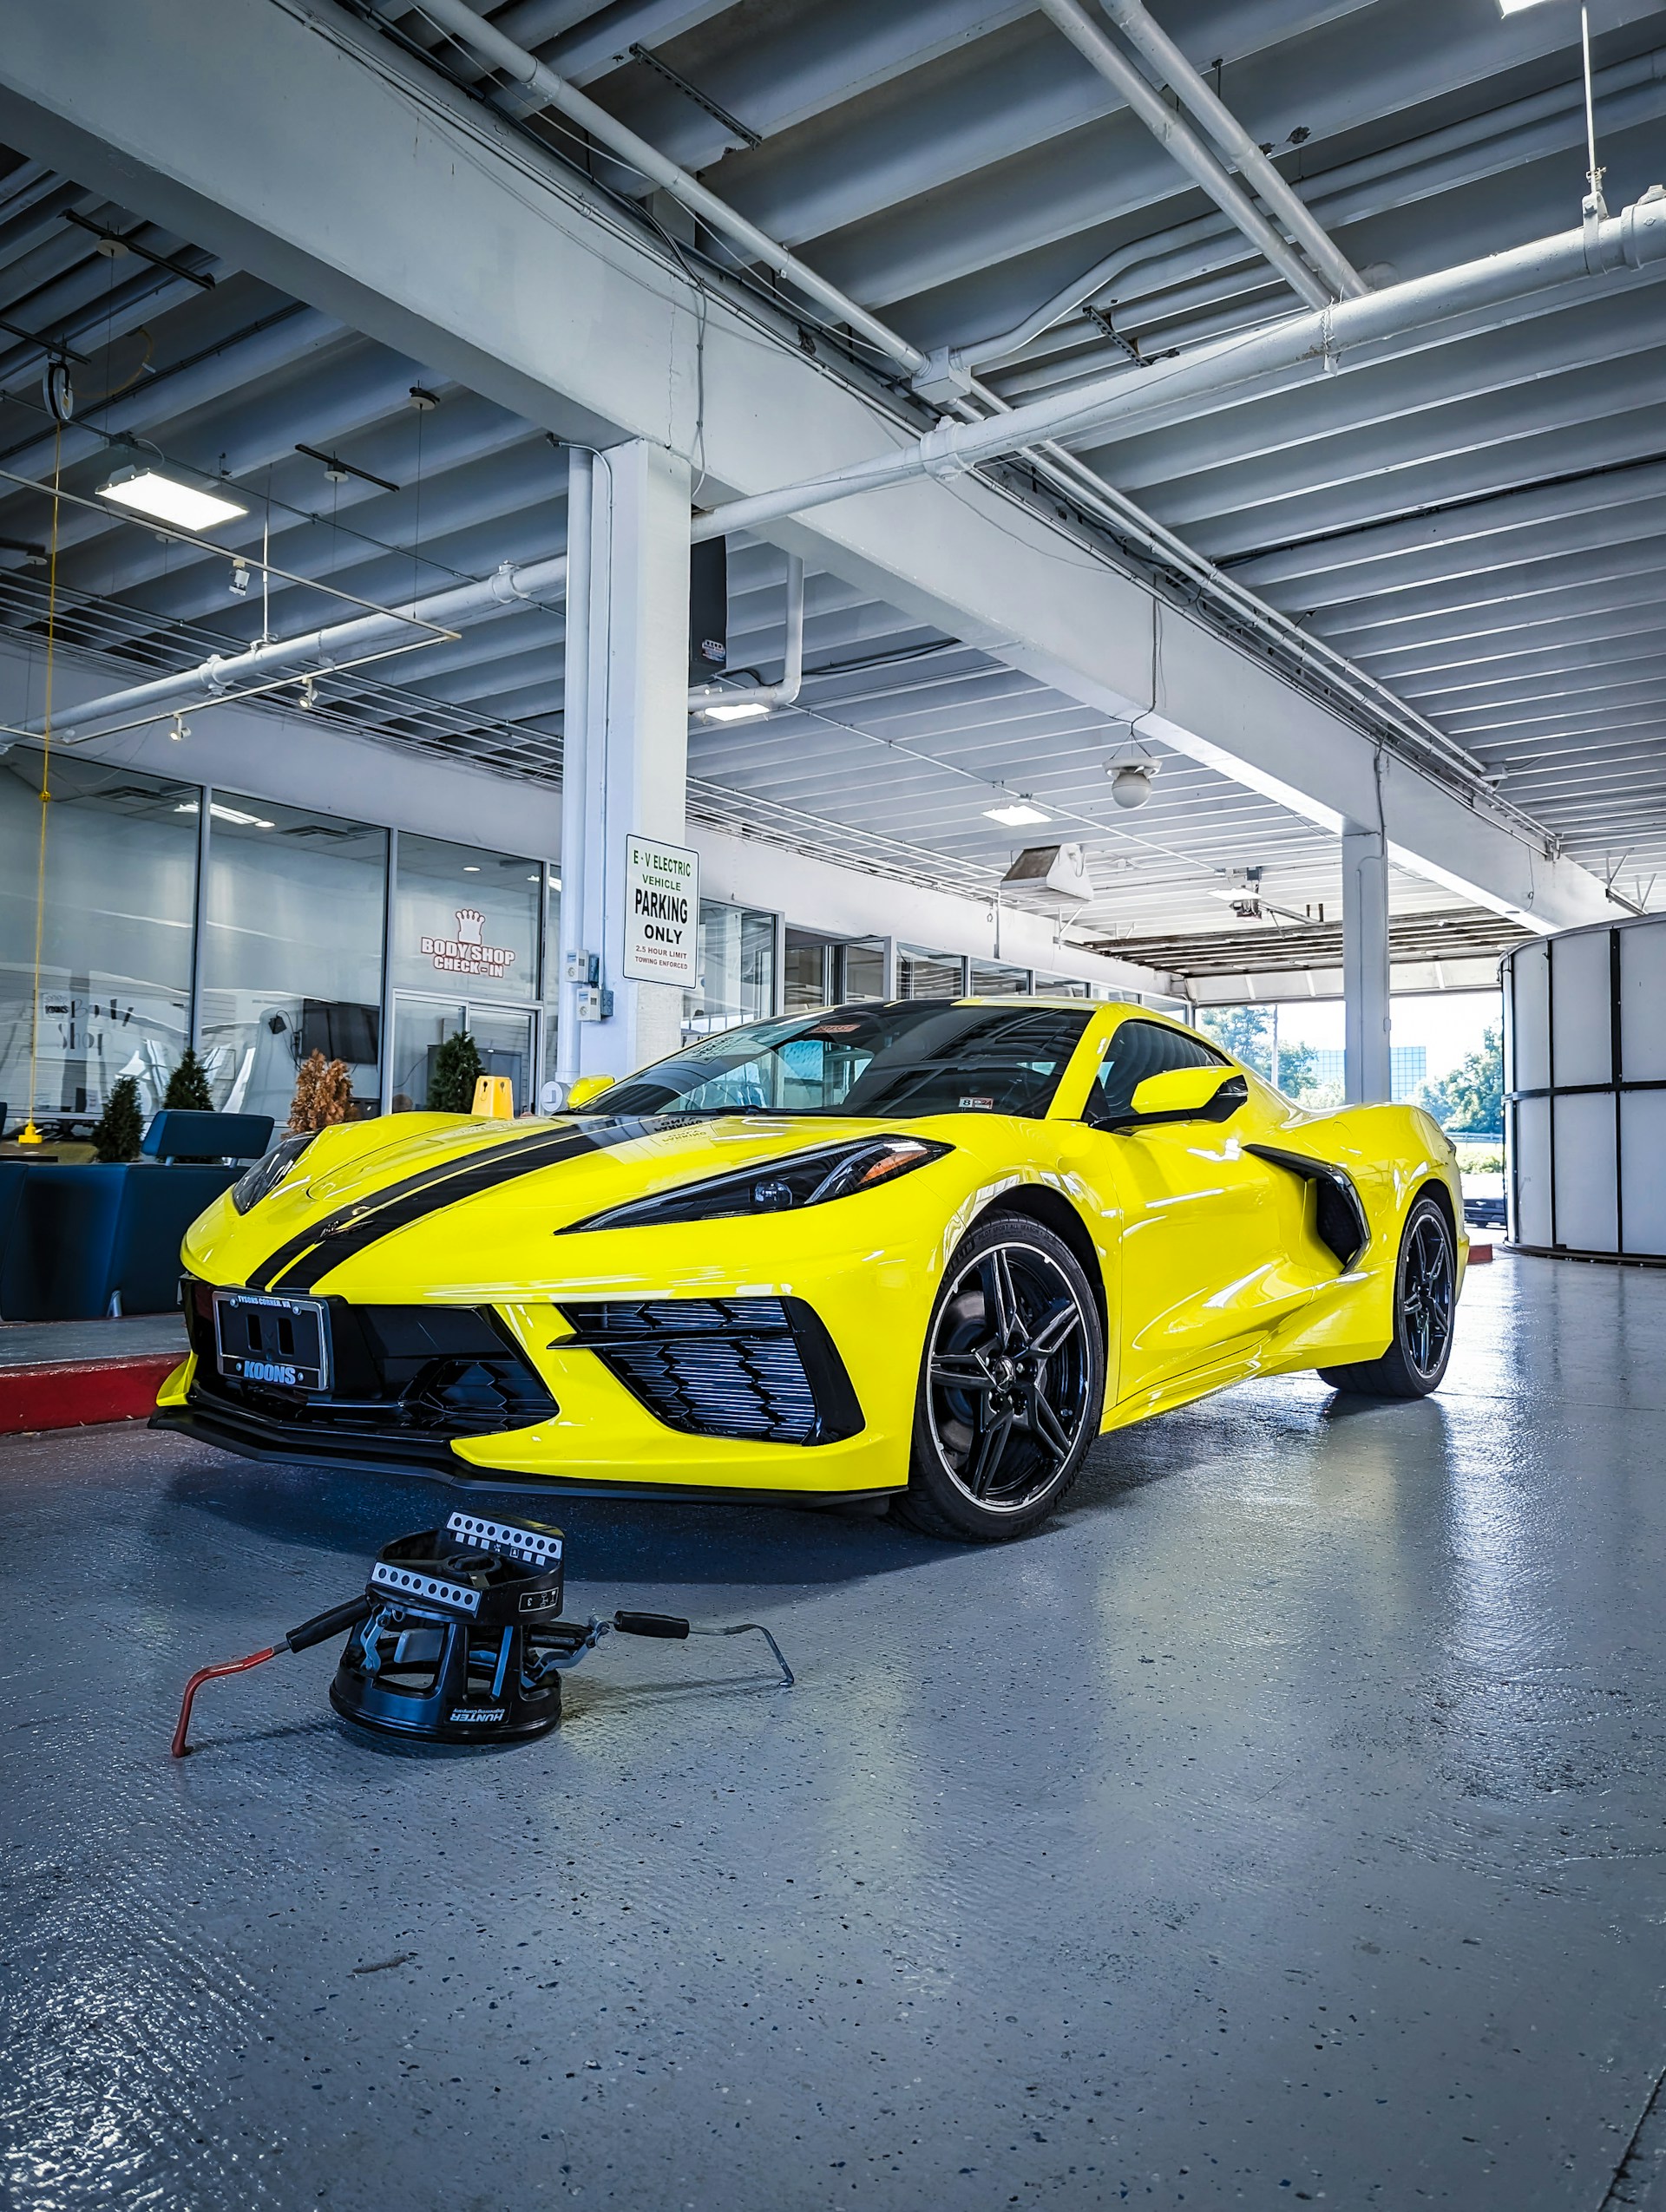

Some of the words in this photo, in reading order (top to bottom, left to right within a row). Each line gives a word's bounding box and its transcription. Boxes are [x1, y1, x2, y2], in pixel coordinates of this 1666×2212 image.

[653, 854, 691, 877] ELECTRIC
[642, 874, 681, 892] VEHICLE
[635, 888, 688, 924] PARKING
[644, 924, 683, 945] ONLY
[421, 937, 469, 959] BODY
[471, 945, 515, 966] SHOP
[635, 945, 646, 953] 2.5
[647, 946, 668, 957] HOUR
[669, 950, 687, 959] LIMIT
[635, 956, 658, 965] TOWING
[659, 959, 688, 970] ENFORCED
[244, 1360, 296, 1385] KOONS
[450, 1713, 503, 1722] HUNTER
